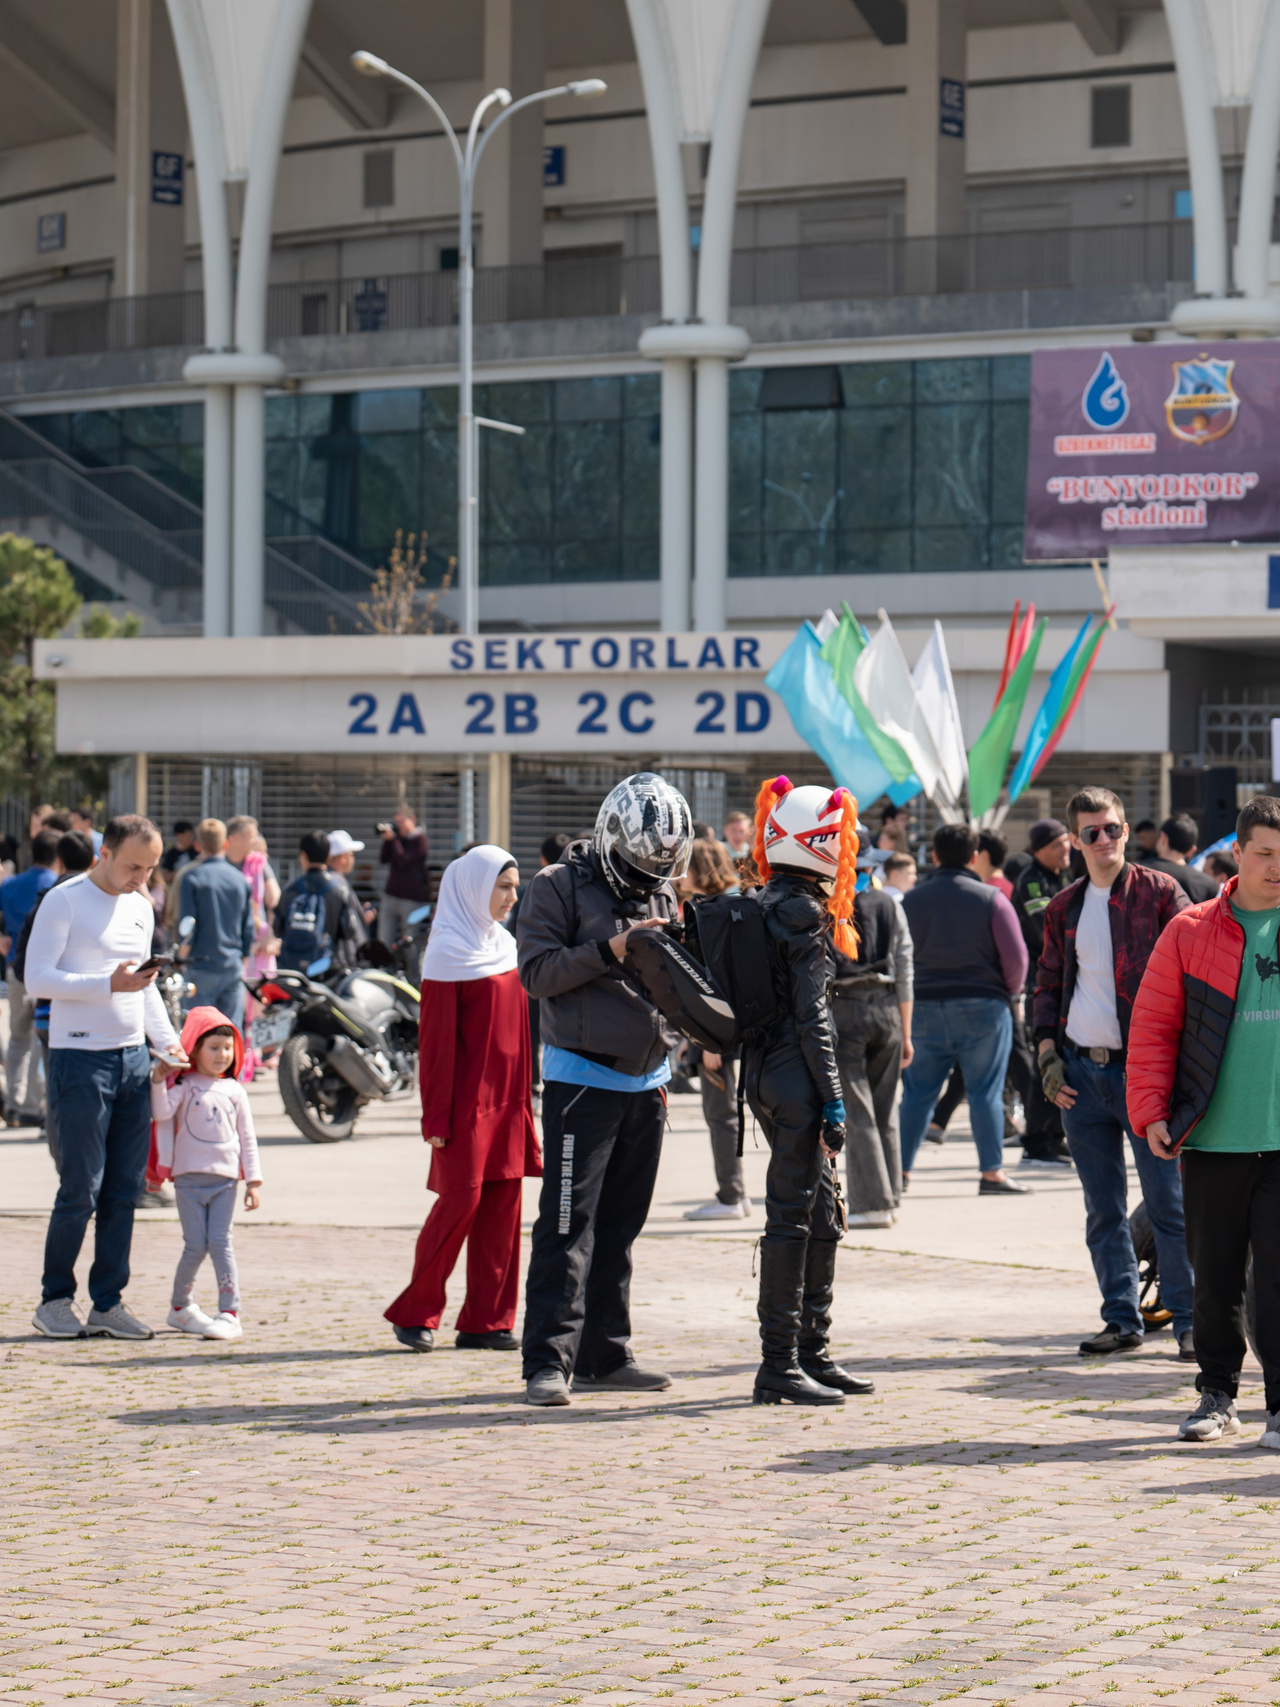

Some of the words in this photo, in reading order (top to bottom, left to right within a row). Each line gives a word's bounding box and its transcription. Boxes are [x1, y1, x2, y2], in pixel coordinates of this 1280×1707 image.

[1103, 500, 1206, 528] stadioni
[450, 636, 761, 670] SEKTORLAR
[348, 692, 426, 734] 2A
[464, 692, 538, 734] 2B
[576, 691, 655, 733] 2C
[694, 691, 771, 733] 2D
[561, 1160, 573, 1178] THE
[558, 1179, 572, 1234] COLLECTION
